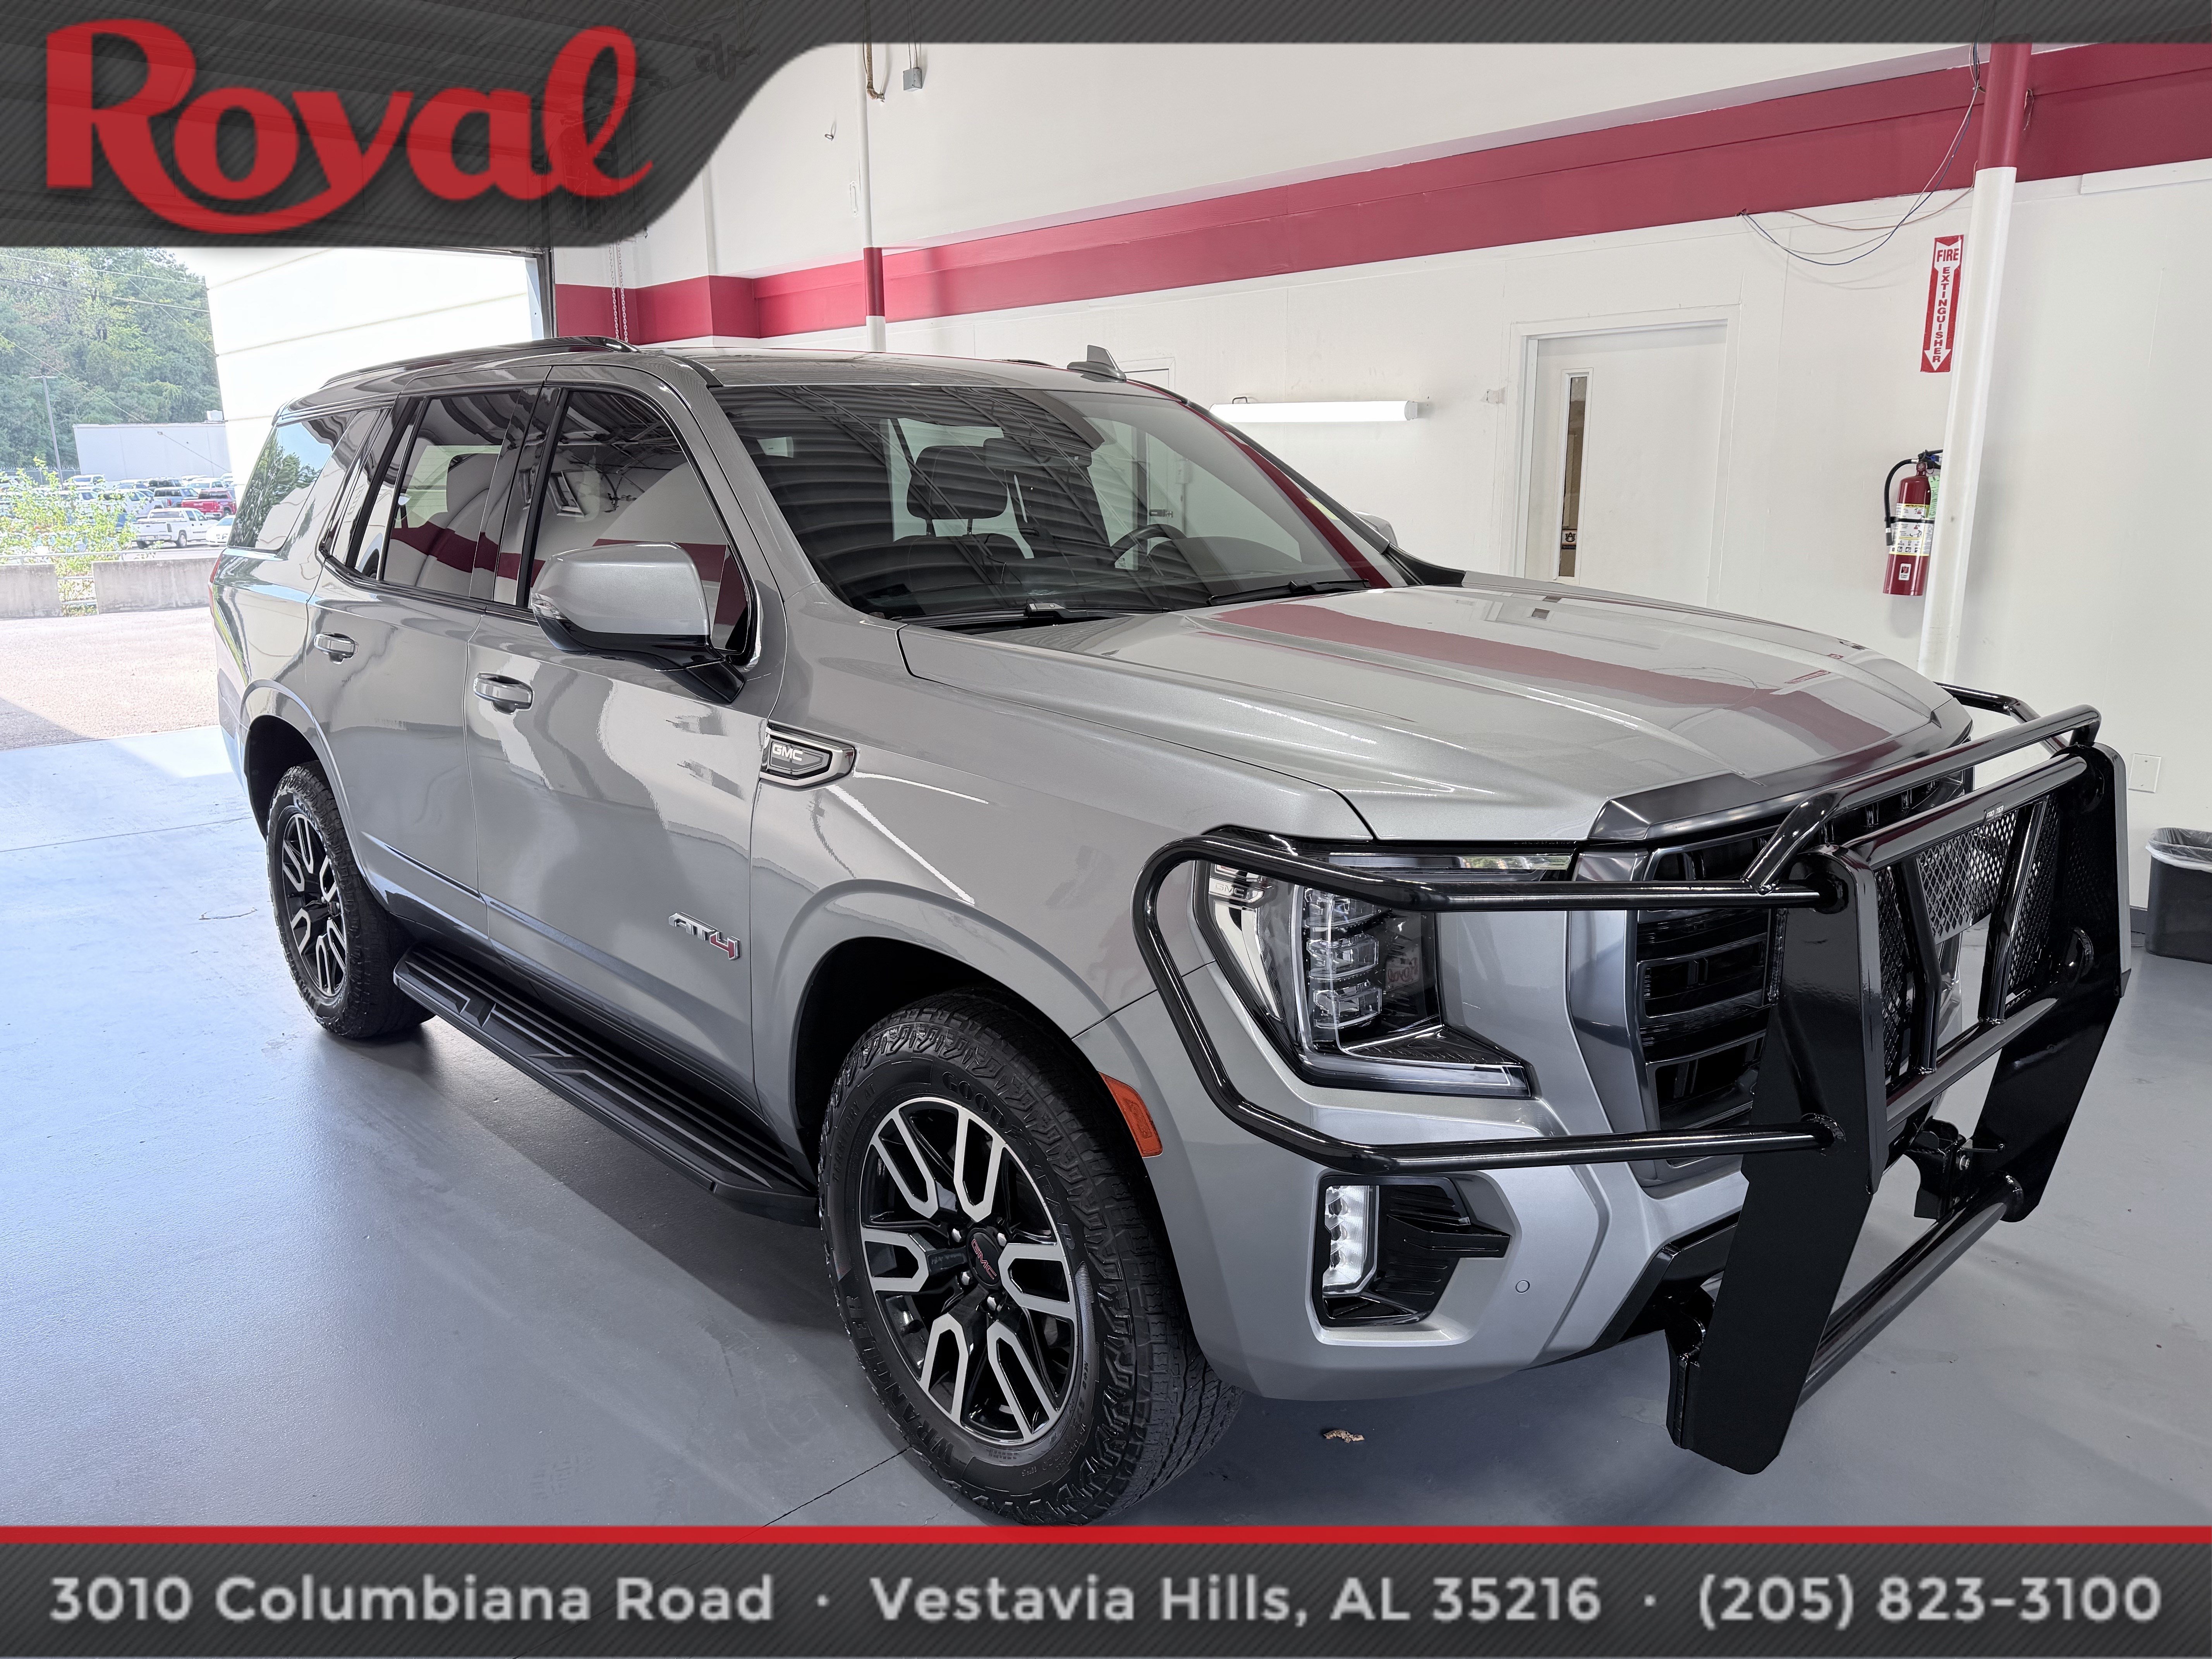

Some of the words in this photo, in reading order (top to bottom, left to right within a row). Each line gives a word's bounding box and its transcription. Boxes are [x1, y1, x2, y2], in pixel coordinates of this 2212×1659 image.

[1937, 248, 1959, 262] FIRE
[1932, 266, 1951, 362] EXTINGUISHER
[772, 744, 803, 761] GMC
[1215, 883, 1244, 898] GMC
[668, 912, 740, 960] AT4
[942, 1071, 1076, 1250] GOODYEAR
[971, 1238, 997, 1280] GMC
[846, 1296, 954, 1467] WRANGLER
